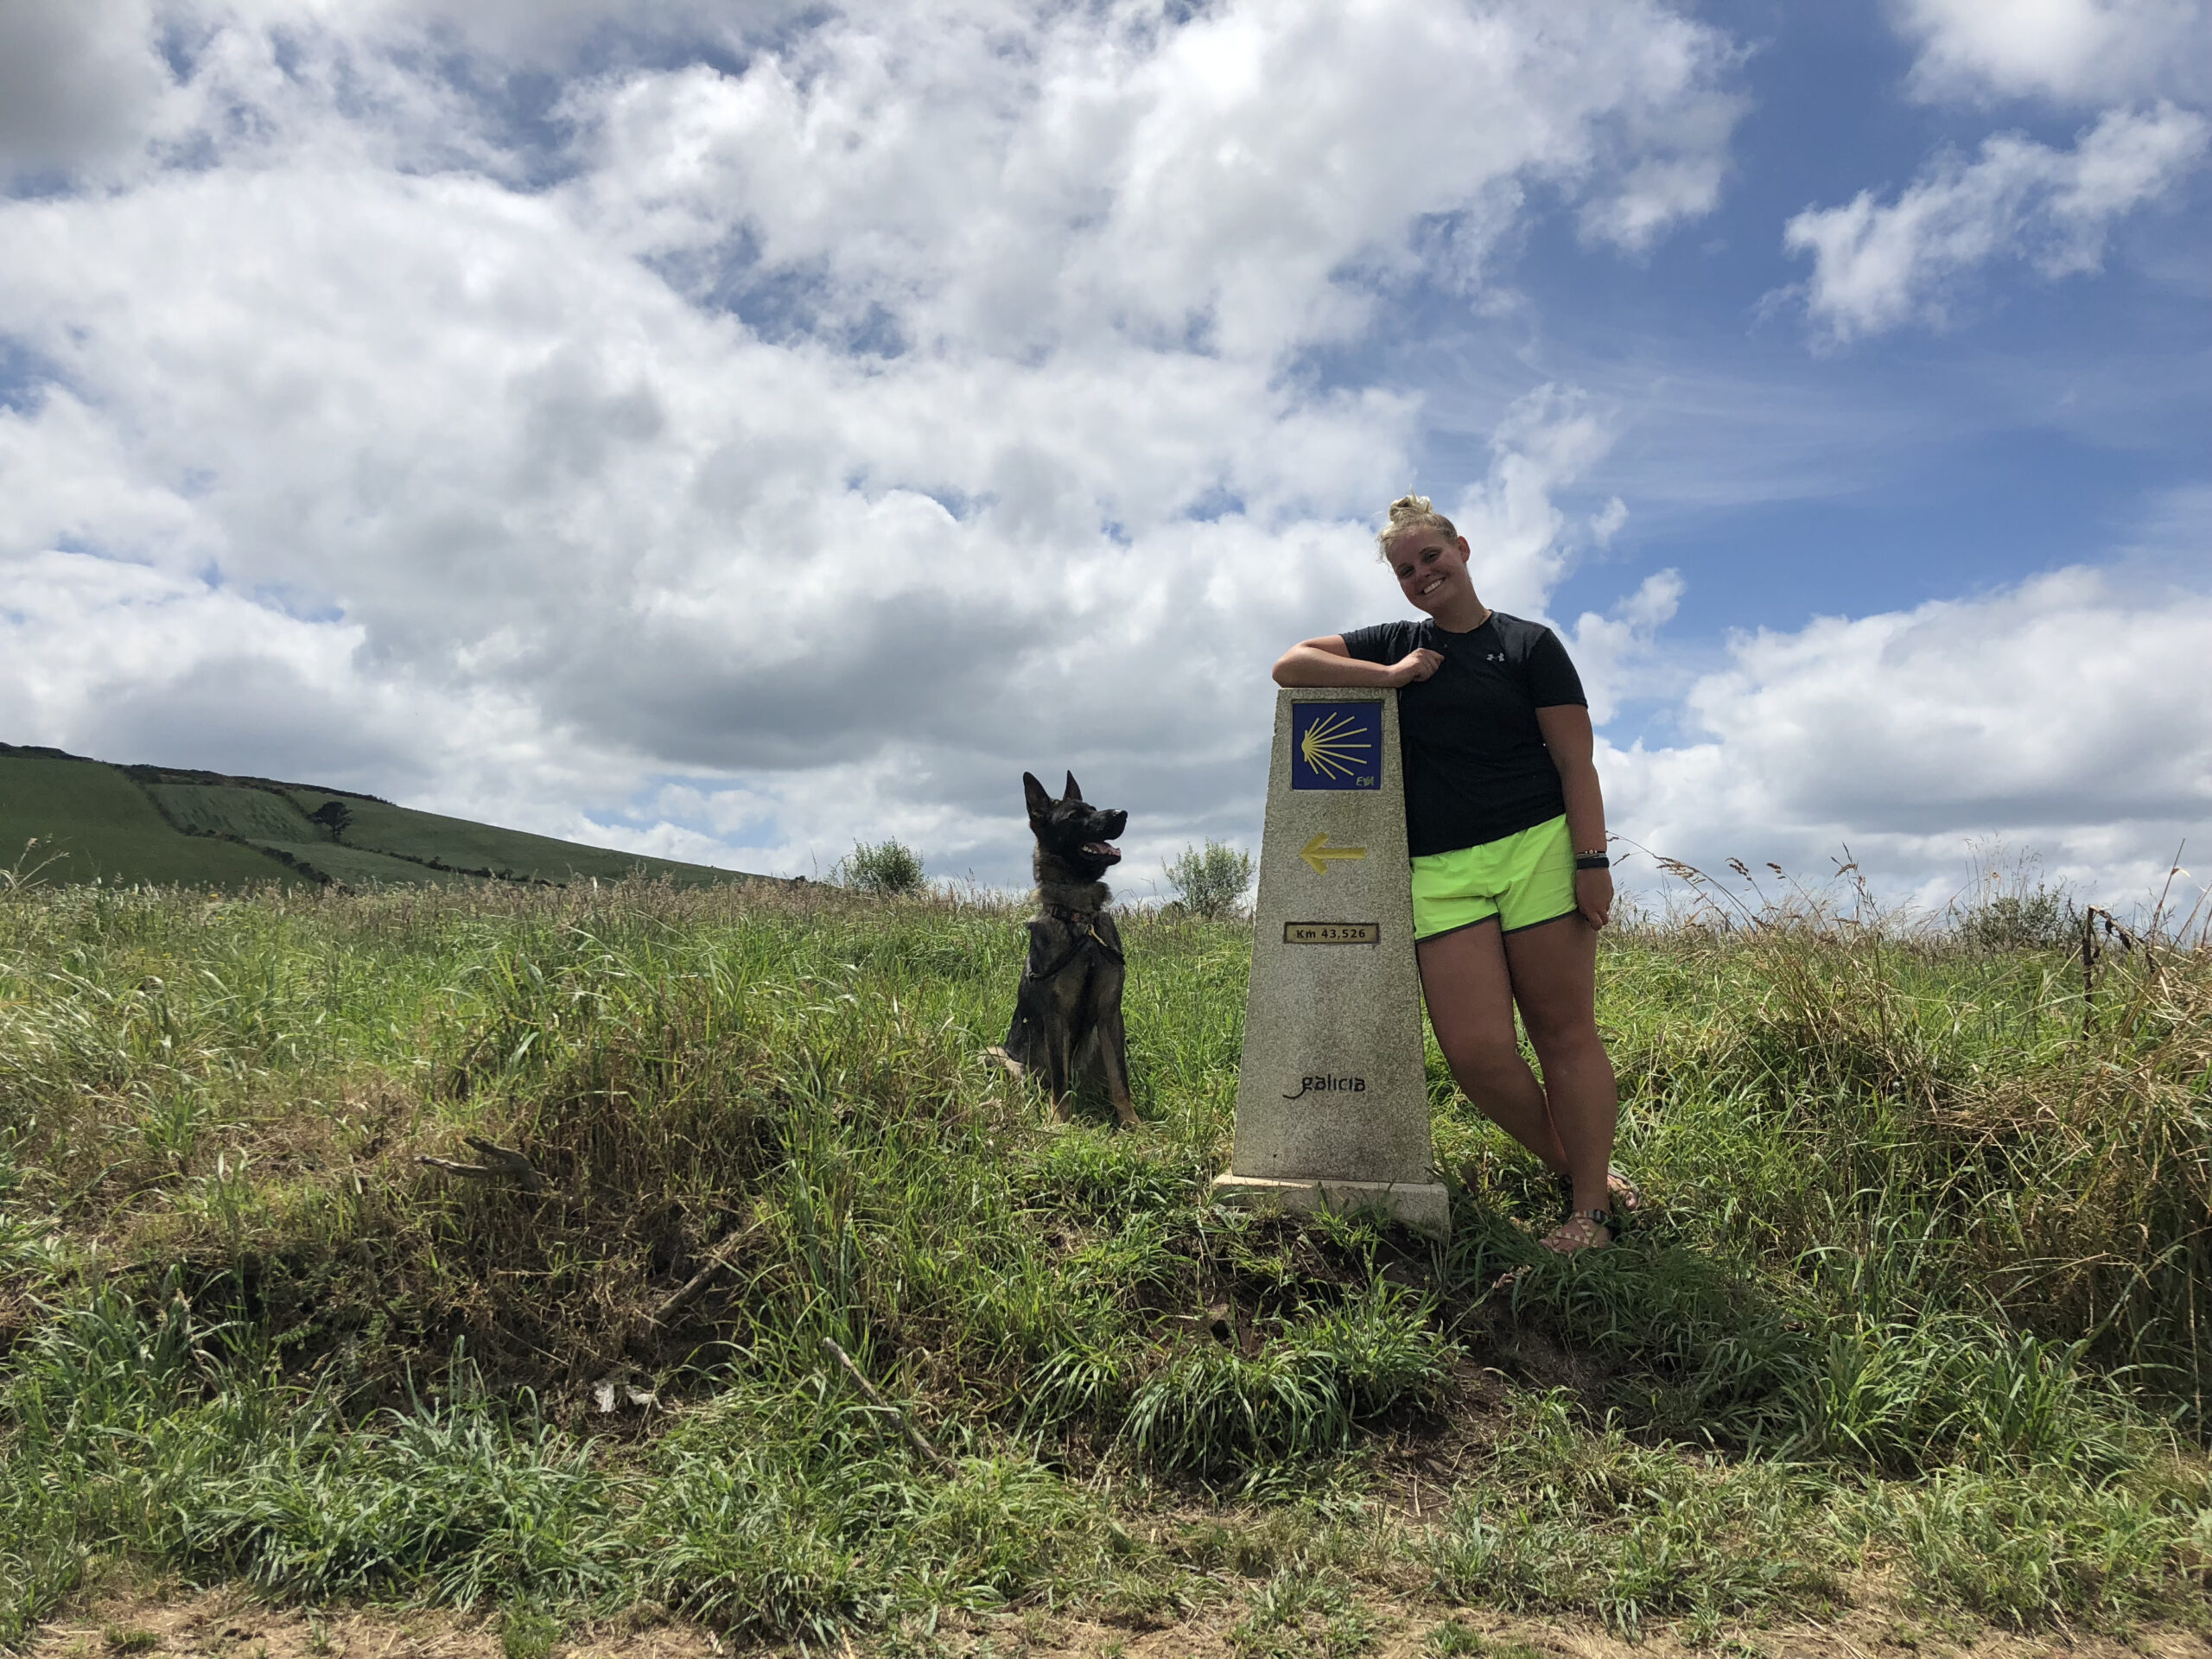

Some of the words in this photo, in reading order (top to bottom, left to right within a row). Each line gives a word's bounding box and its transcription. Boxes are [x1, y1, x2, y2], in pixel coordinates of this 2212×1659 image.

[1296, 930, 1316, 938] Km
[1321, 929, 1366, 940] 43,526
[1282, 1073, 1365, 1100] galicia
